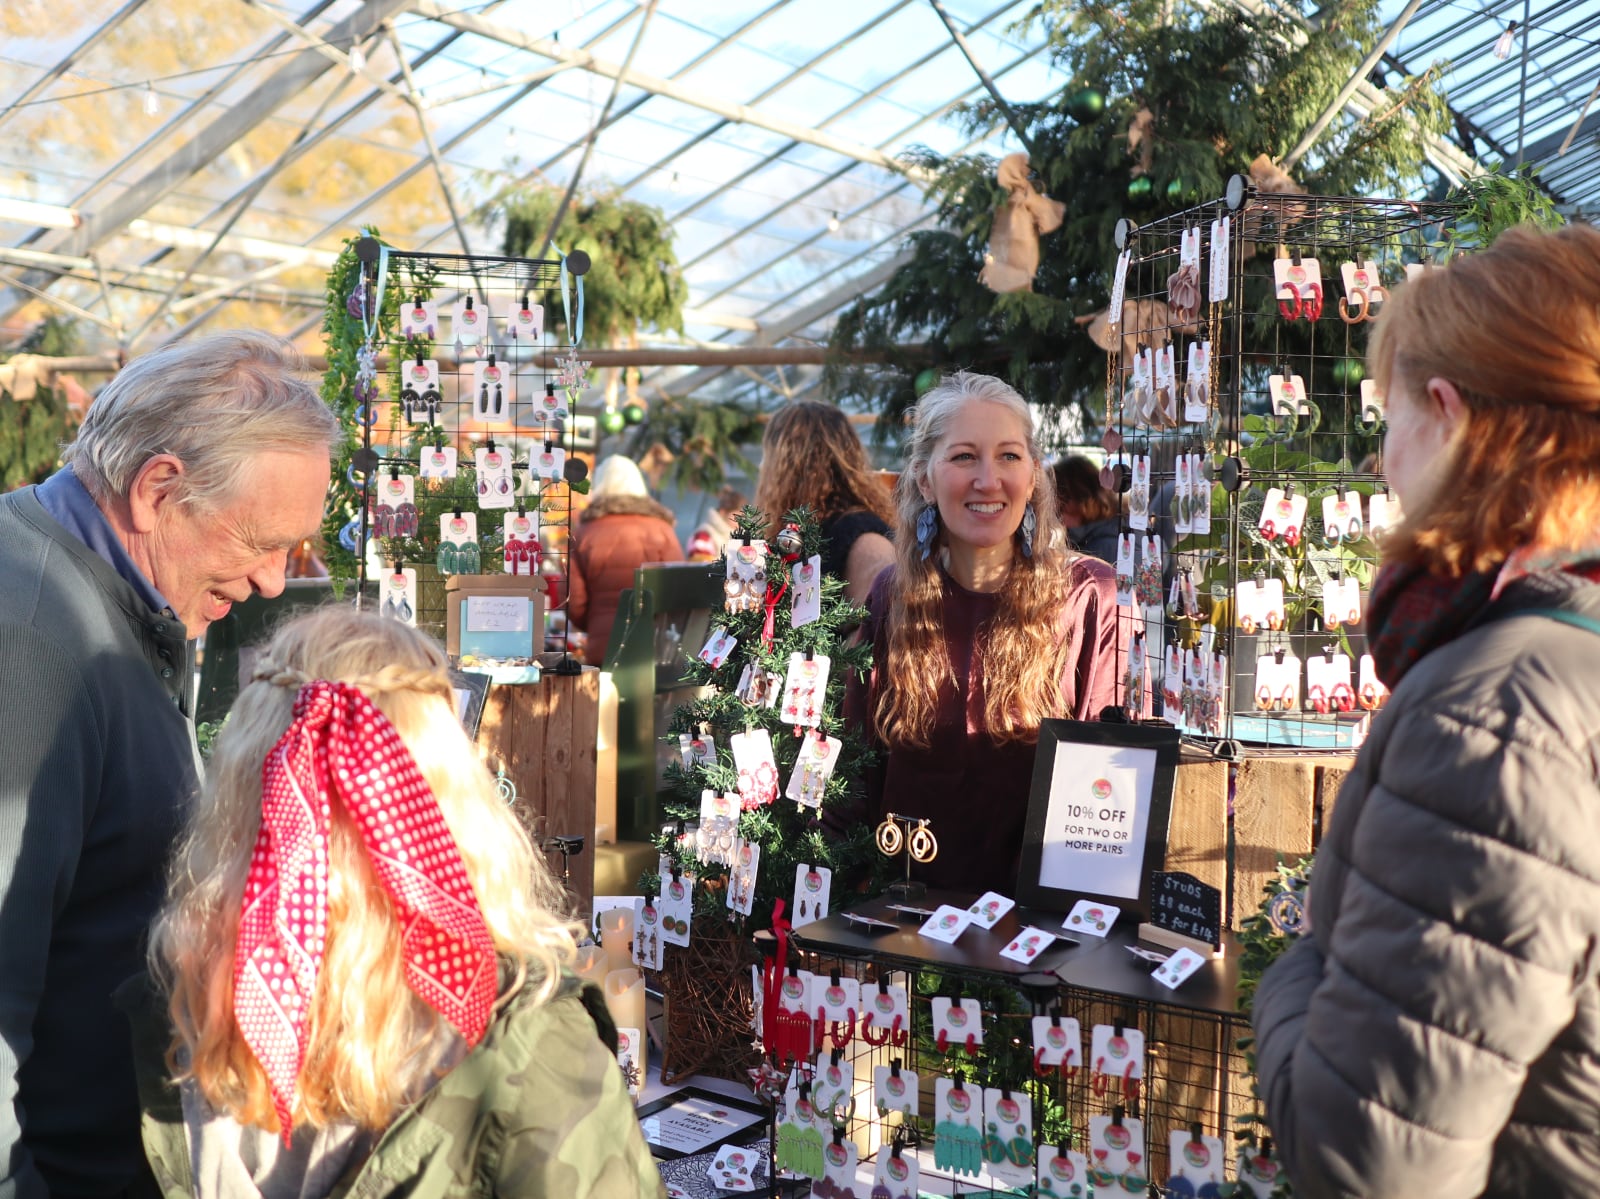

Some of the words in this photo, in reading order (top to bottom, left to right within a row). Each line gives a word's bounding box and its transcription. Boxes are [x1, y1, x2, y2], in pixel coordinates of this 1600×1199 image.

[1068, 804, 1094, 820] 10%
[1099, 808, 1126, 823] OFF
[1064, 824, 1084, 835] FOR
[1087, 827, 1110, 838] TWO
[1113, 830, 1128, 841] OR
[1065, 839, 1093, 851] MORE
[1096, 843, 1124, 855] PAIRS
[1164, 876, 1202, 899] STUDS
[1178, 903, 1206, 919] each
[1159, 912, 1166, 924] 2
[1171, 916, 1189, 929] for
[1191, 922, 1213, 941] £14
[667, 1119, 713, 1134] AVAILABLE
